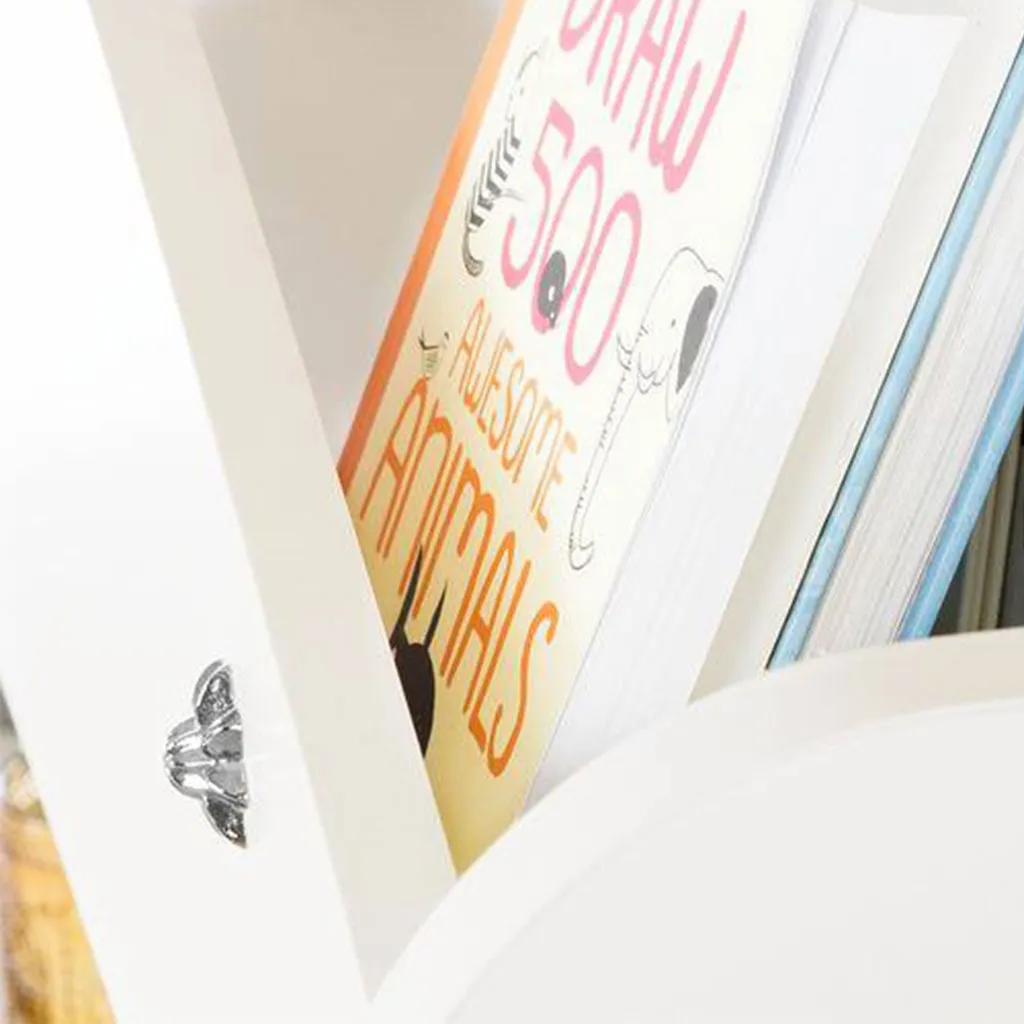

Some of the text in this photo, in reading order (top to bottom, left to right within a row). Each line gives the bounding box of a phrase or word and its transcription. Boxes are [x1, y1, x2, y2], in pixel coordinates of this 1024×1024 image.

[501, 98, 642, 387] 500
[449, 298, 578, 534] AWESOME
[359, 373, 559, 779] ANIMALS
